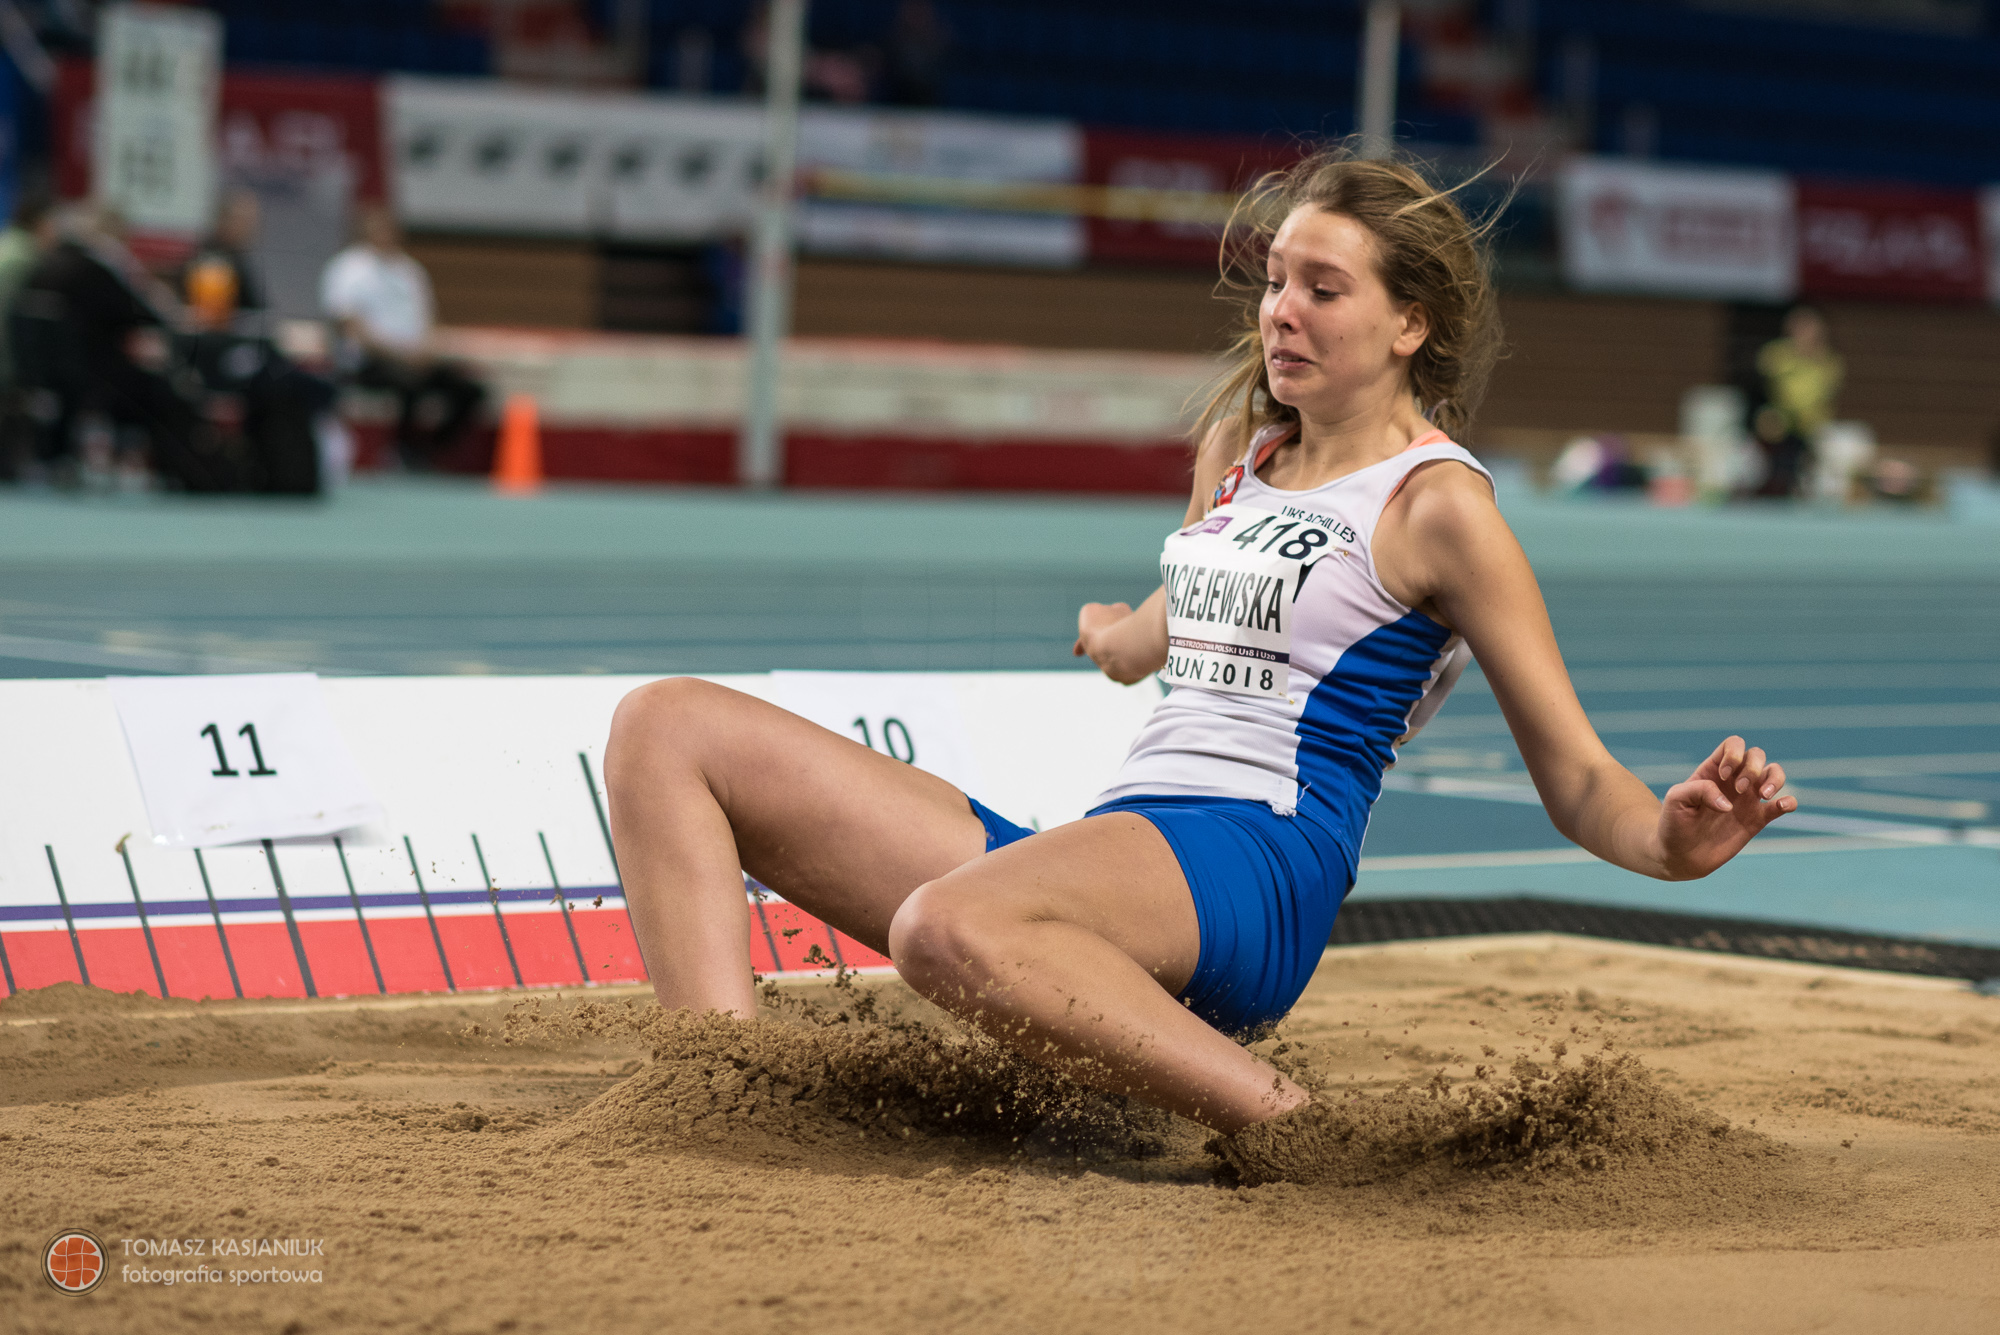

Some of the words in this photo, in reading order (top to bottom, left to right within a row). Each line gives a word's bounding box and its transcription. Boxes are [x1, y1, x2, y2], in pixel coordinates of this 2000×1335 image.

[1232, 515, 1328, 560] 418
[1281, 506, 1305, 519] UKS
[1304, 513, 1357, 543] ACHILLES
[1175, 639, 1215, 651] MISTRZOSTWA
[1214, 643, 1237, 654] POLSKI
[1238, 647, 1255, 657] U18
[1260, 651, 1276, 661] U20
[1208, 661, 1274, 691] 2018
[200, 722, 278, 778] 11
[853, 716, 915, 765] 10
